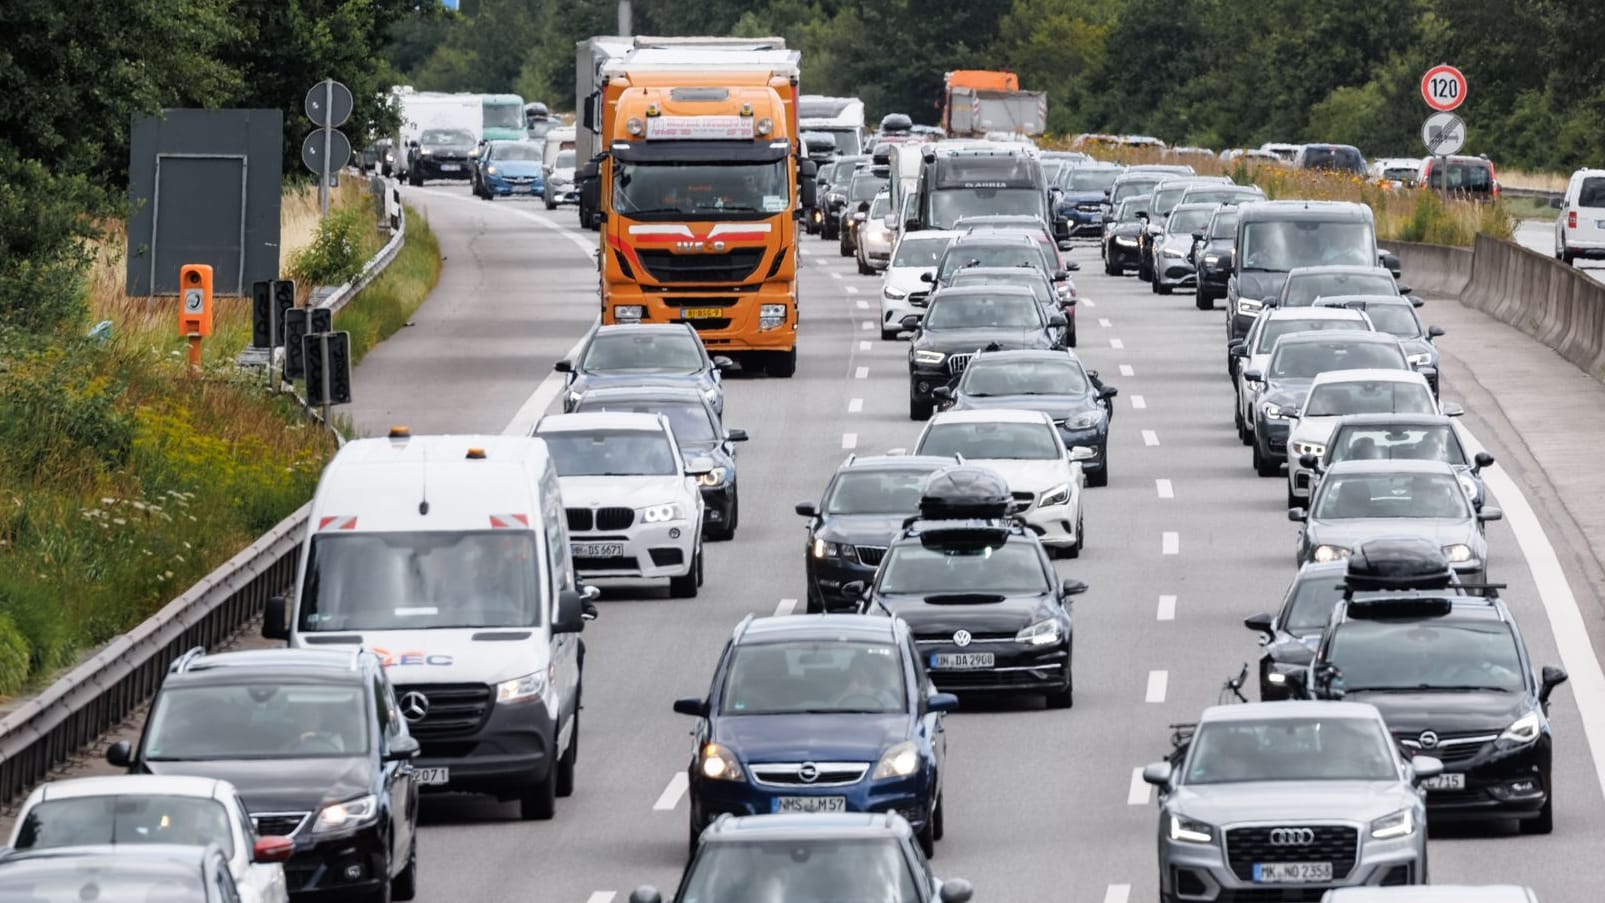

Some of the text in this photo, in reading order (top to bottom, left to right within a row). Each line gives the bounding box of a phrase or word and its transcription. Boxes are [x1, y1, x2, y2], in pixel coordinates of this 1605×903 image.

[1431, 78, 1457, 98] 120
[677, 241, 725, 253] IVEO
[601, 545, 621, 555] 6671
[956, 655, 968, 666] DA
[413, 769, 447, 783] 2071
[829, 799, 844, 811] 57
